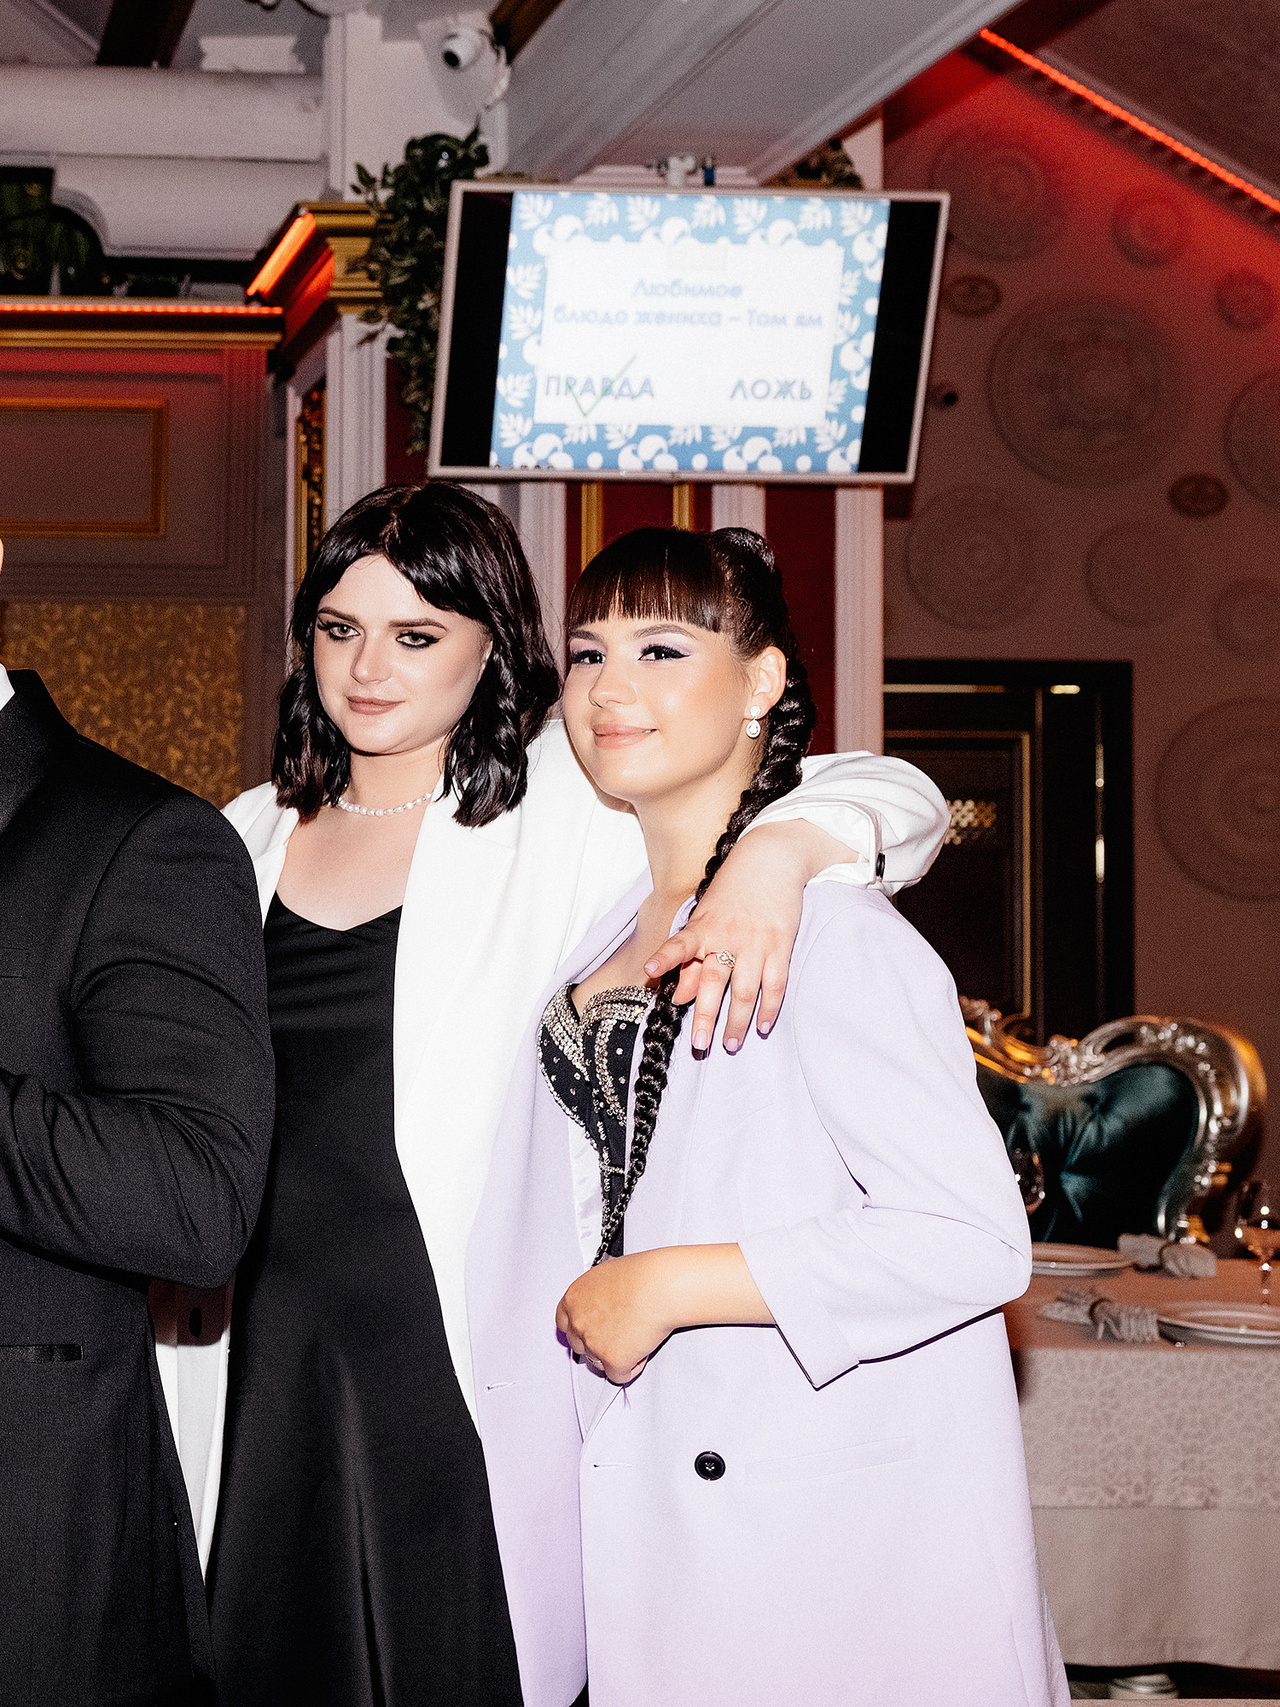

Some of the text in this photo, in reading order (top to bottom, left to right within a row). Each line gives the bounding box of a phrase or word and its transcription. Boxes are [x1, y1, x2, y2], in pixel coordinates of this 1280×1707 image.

[633, 279, 743, 298] Любимое
[553, 305, 628, 325] блюдо
[634, 310, 723, 326] жениха
[747, 309, 787, 327] Том
[545, 376, 655, 401] ПРАВДА
[730, 379, 812, 401] ЛОЖЬ
